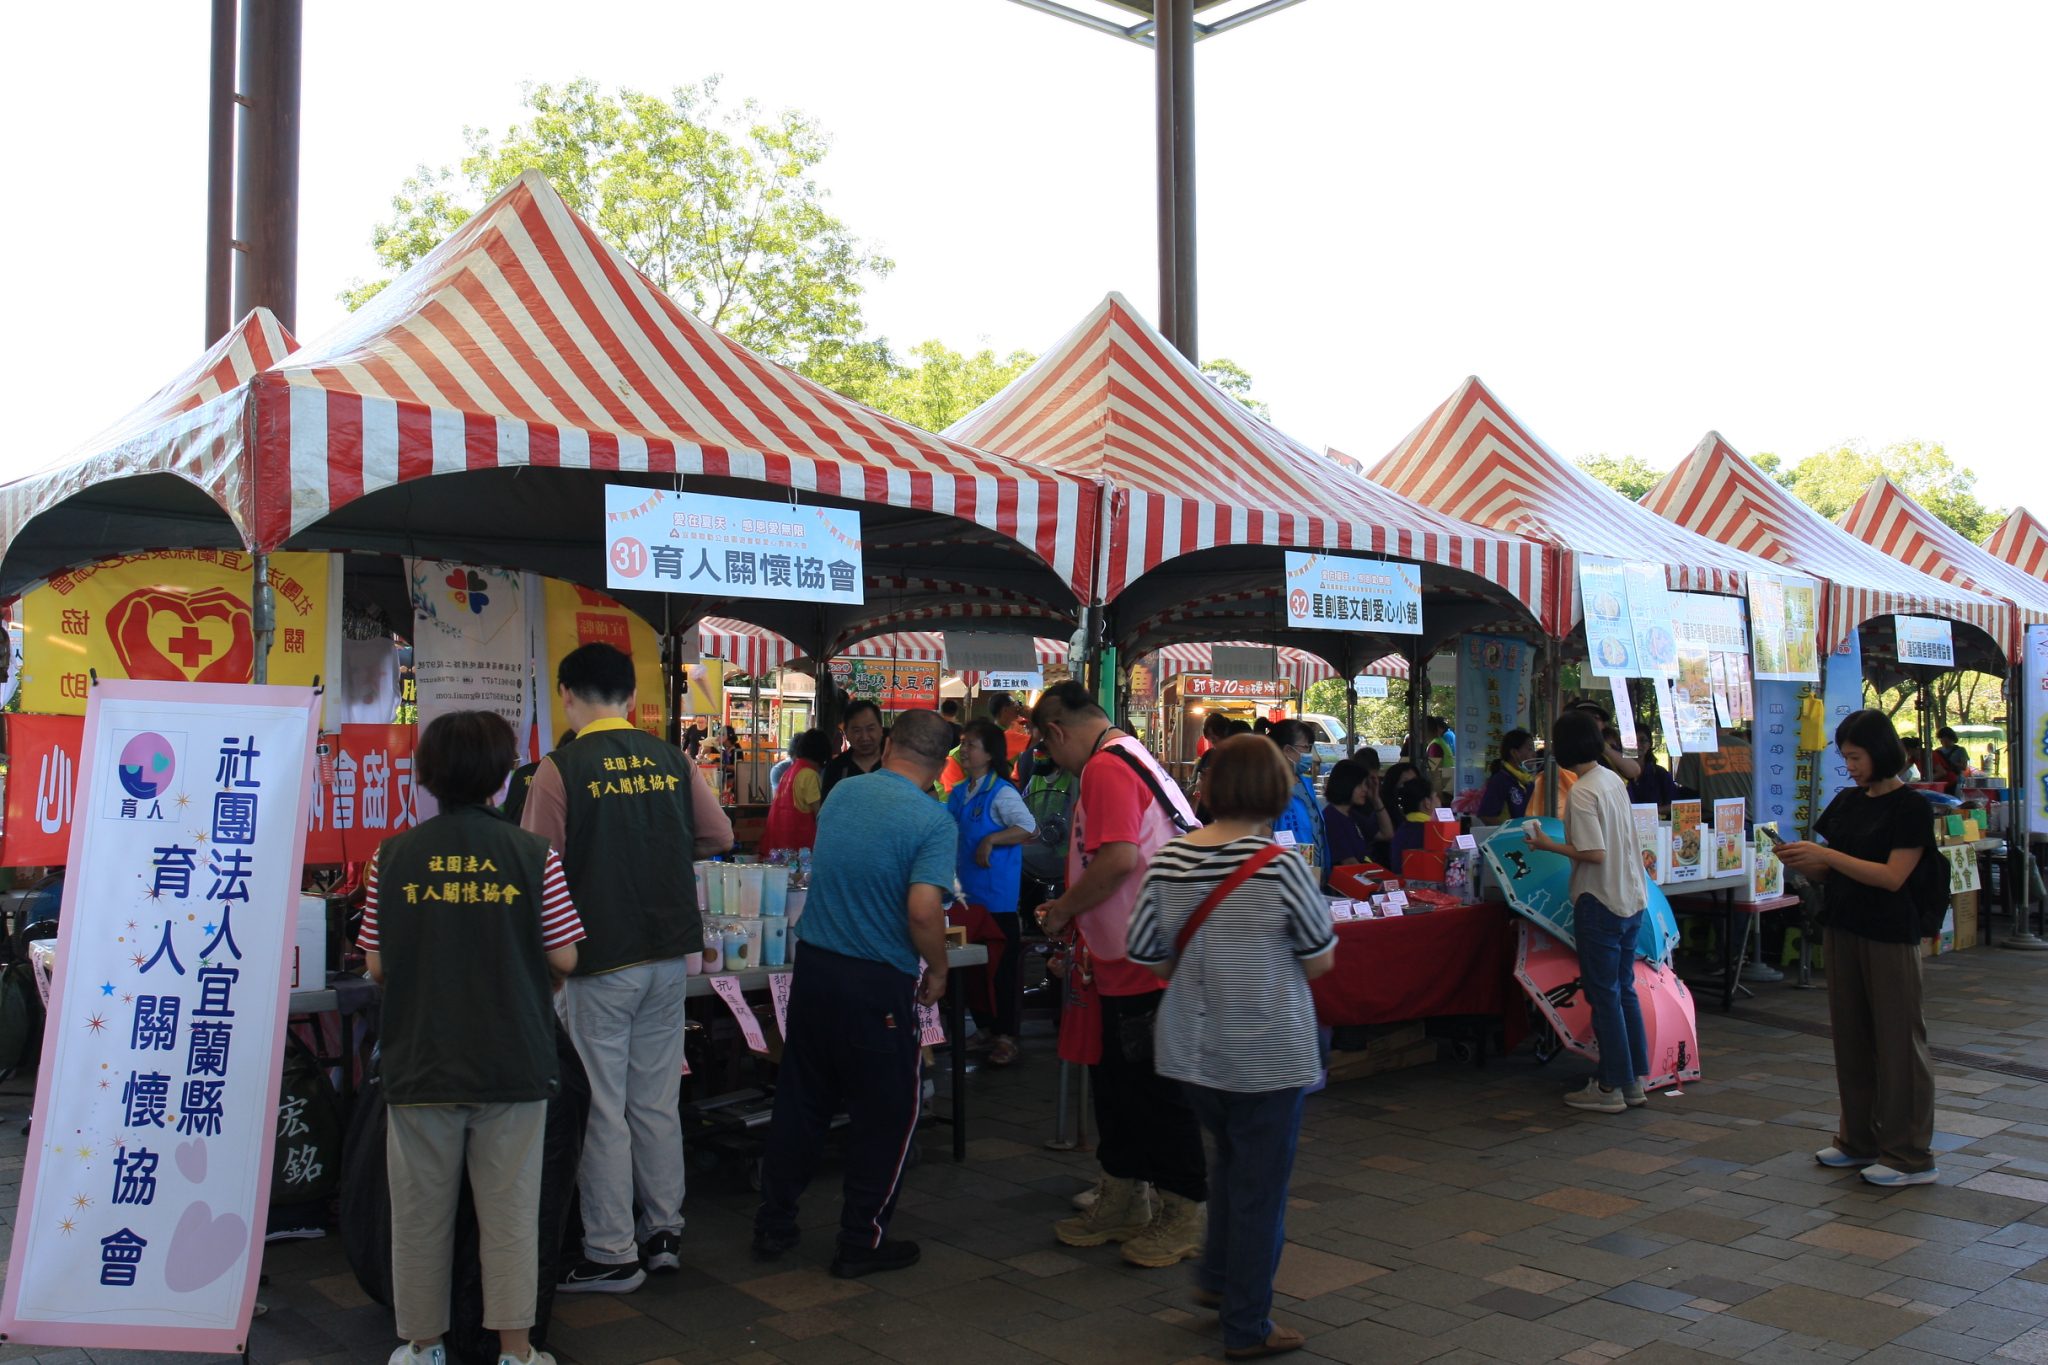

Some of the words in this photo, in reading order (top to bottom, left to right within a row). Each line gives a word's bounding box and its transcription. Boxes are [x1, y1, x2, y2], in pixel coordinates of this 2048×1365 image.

[615, 542, 642, 571] 31
[650, 544, 857, 593] 育人關懷協會
[1292, 595, 1308, 615] 32
[587, 774, 680, 798] 育人關懷協會
[120, 799, 164, 820] 育人
[402, 881, 521, 904] 育人關懷協會
[176, 735, 261, 1136] 社團法人宜蘭縣
[100, 844, 197, 1287] 育人關懷協會
